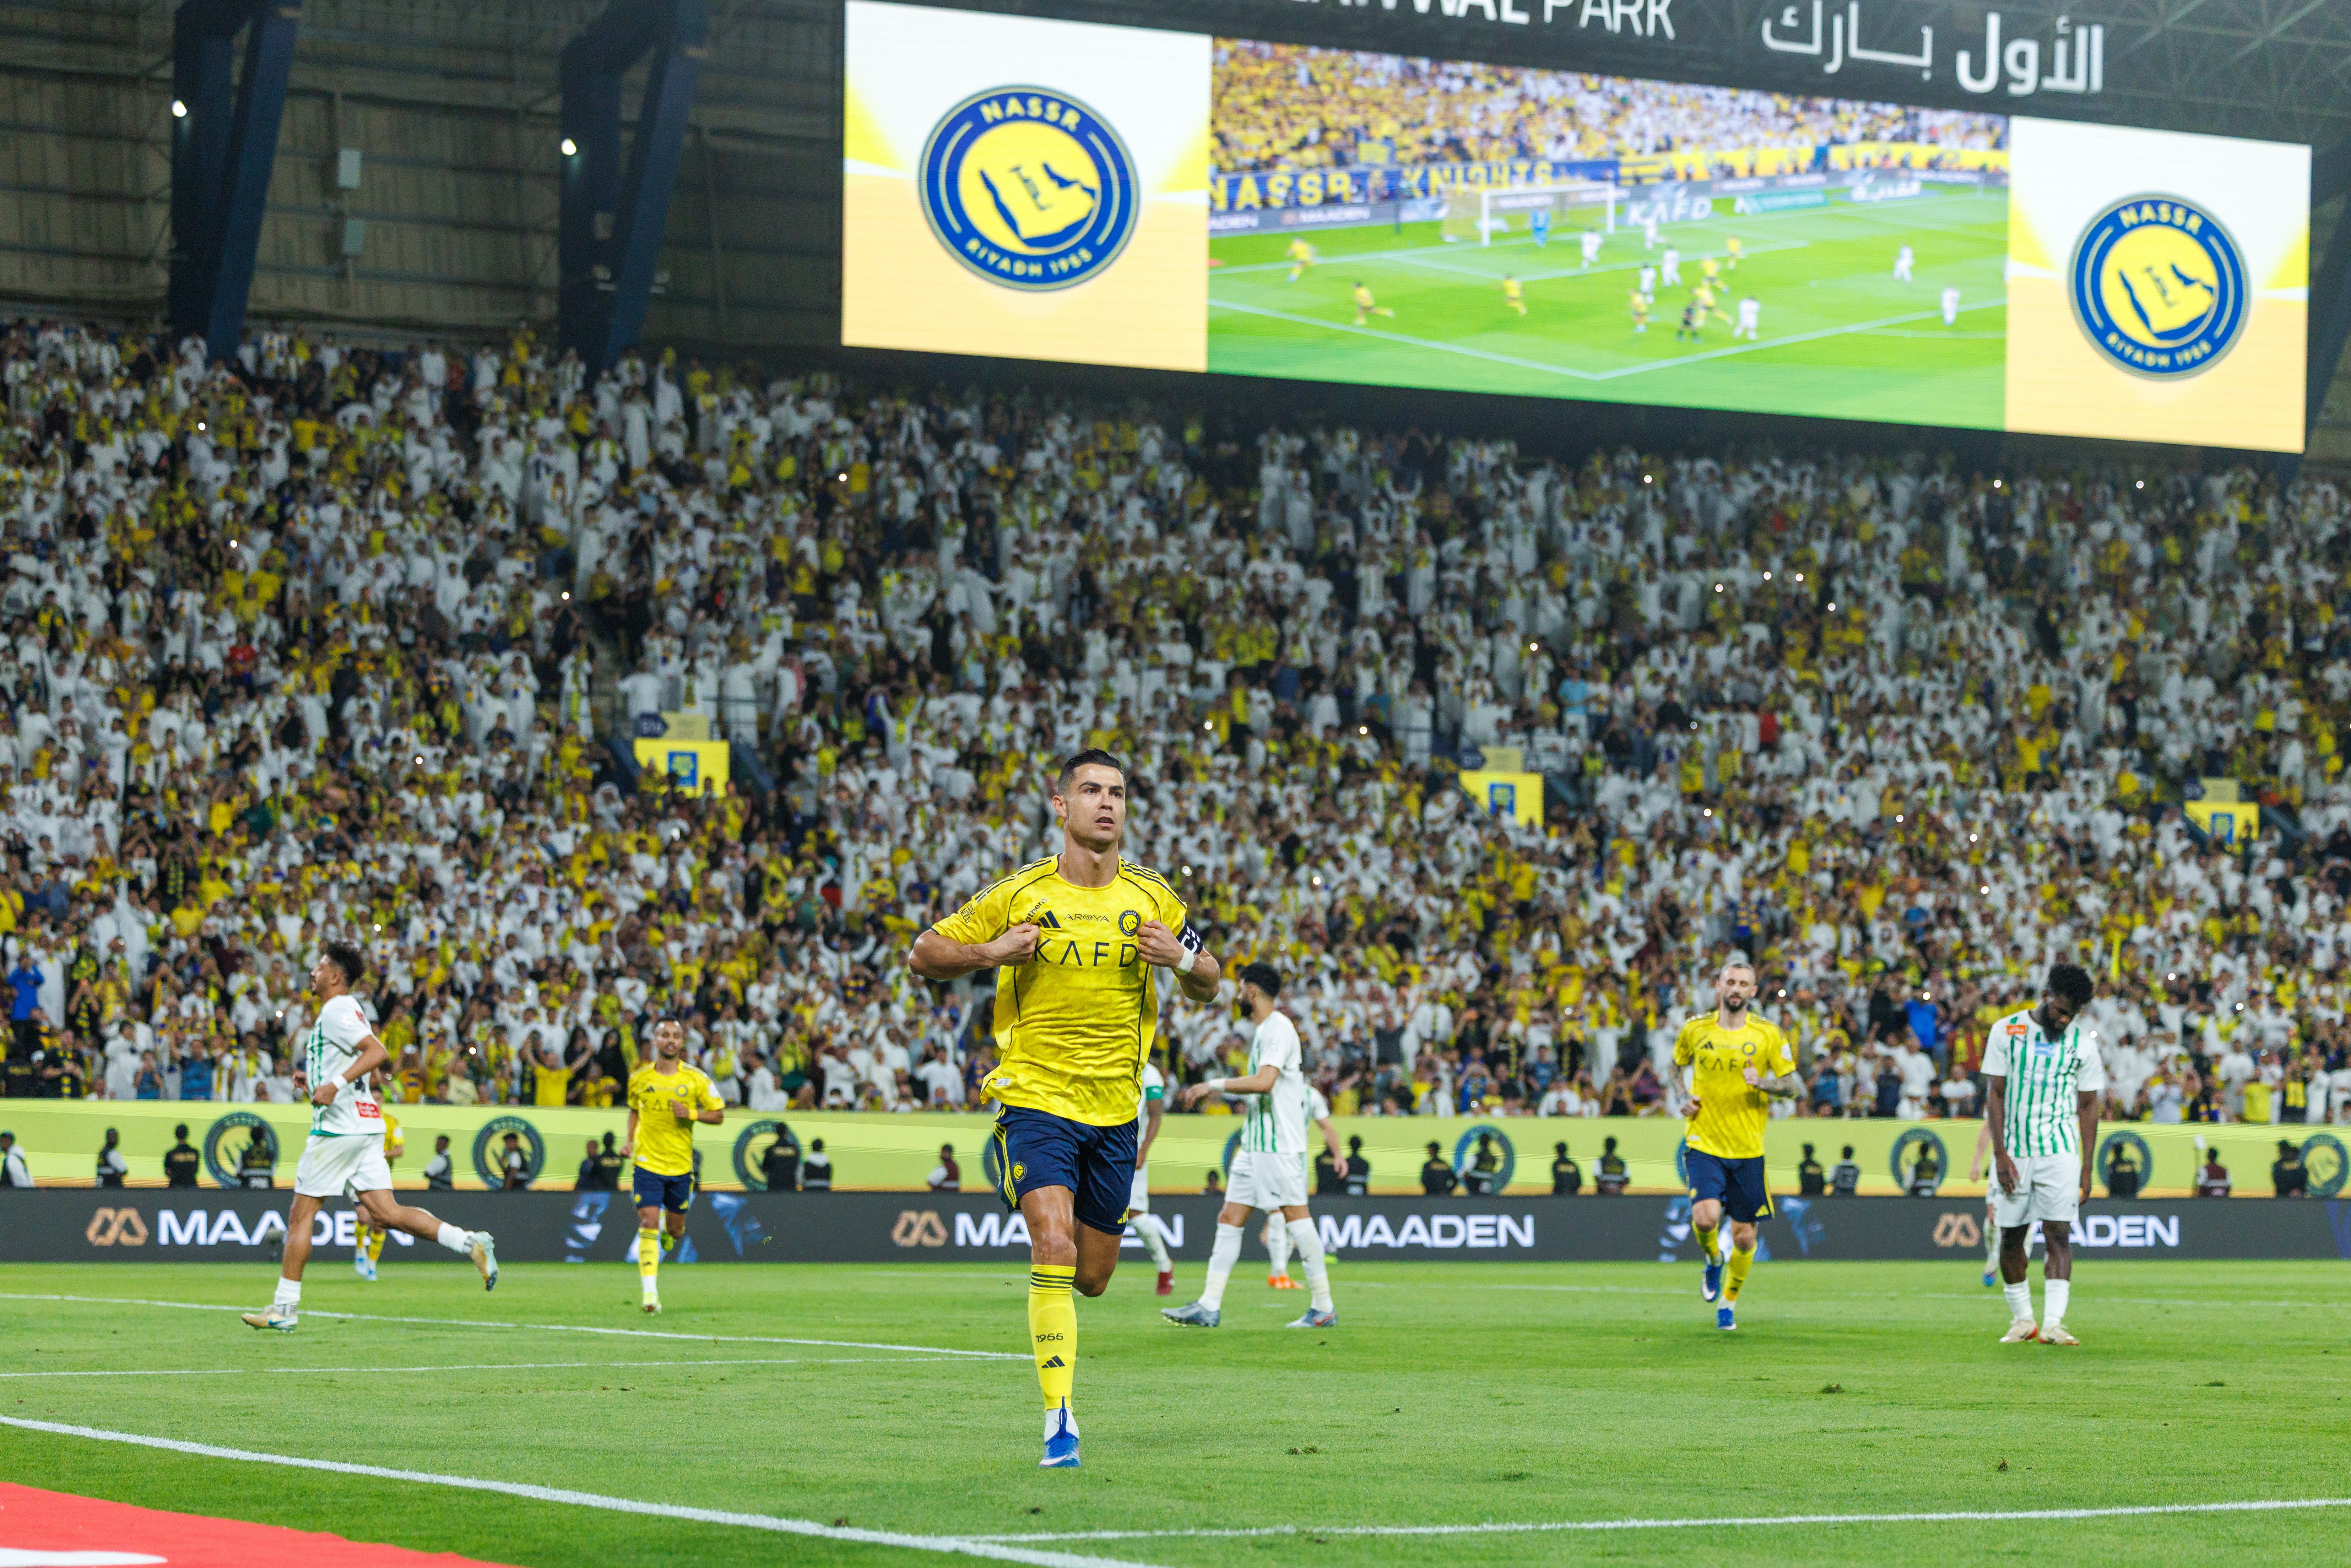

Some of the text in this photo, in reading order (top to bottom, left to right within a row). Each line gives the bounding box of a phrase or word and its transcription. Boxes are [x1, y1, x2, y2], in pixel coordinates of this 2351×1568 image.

[1956, 12, 2103, 96] الأول
[979, 97, 1080, 132] NASSR
[2119, 202, 2203, 235] NASSR
[1034, 939, 1138, 968] KAFD
[1319, 1214, 1535, 1248] MAADEN
[1036, 1333, 1063, 1342] 1955
